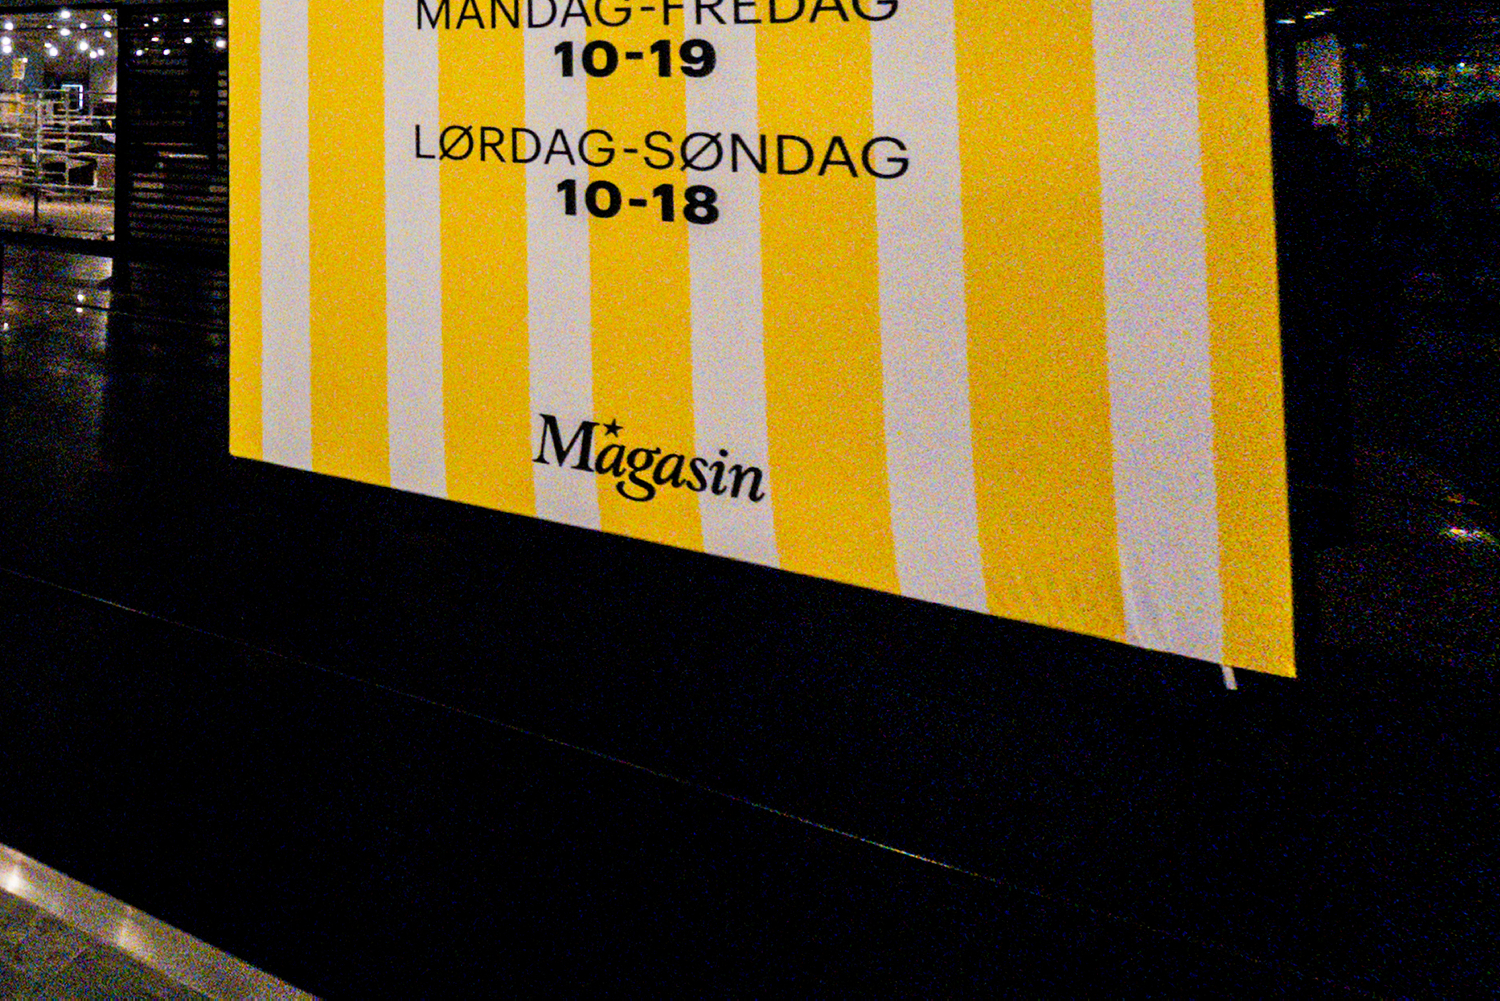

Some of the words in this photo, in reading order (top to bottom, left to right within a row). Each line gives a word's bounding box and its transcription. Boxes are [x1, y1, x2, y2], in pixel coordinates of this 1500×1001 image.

[553, 38, 718, 78] 10-19
[413, 124, 911, 180] LØRDAG-SØNDAG
[556, 178, 720, 225] 10-18
[532, 413, 765, 502] Magasin
